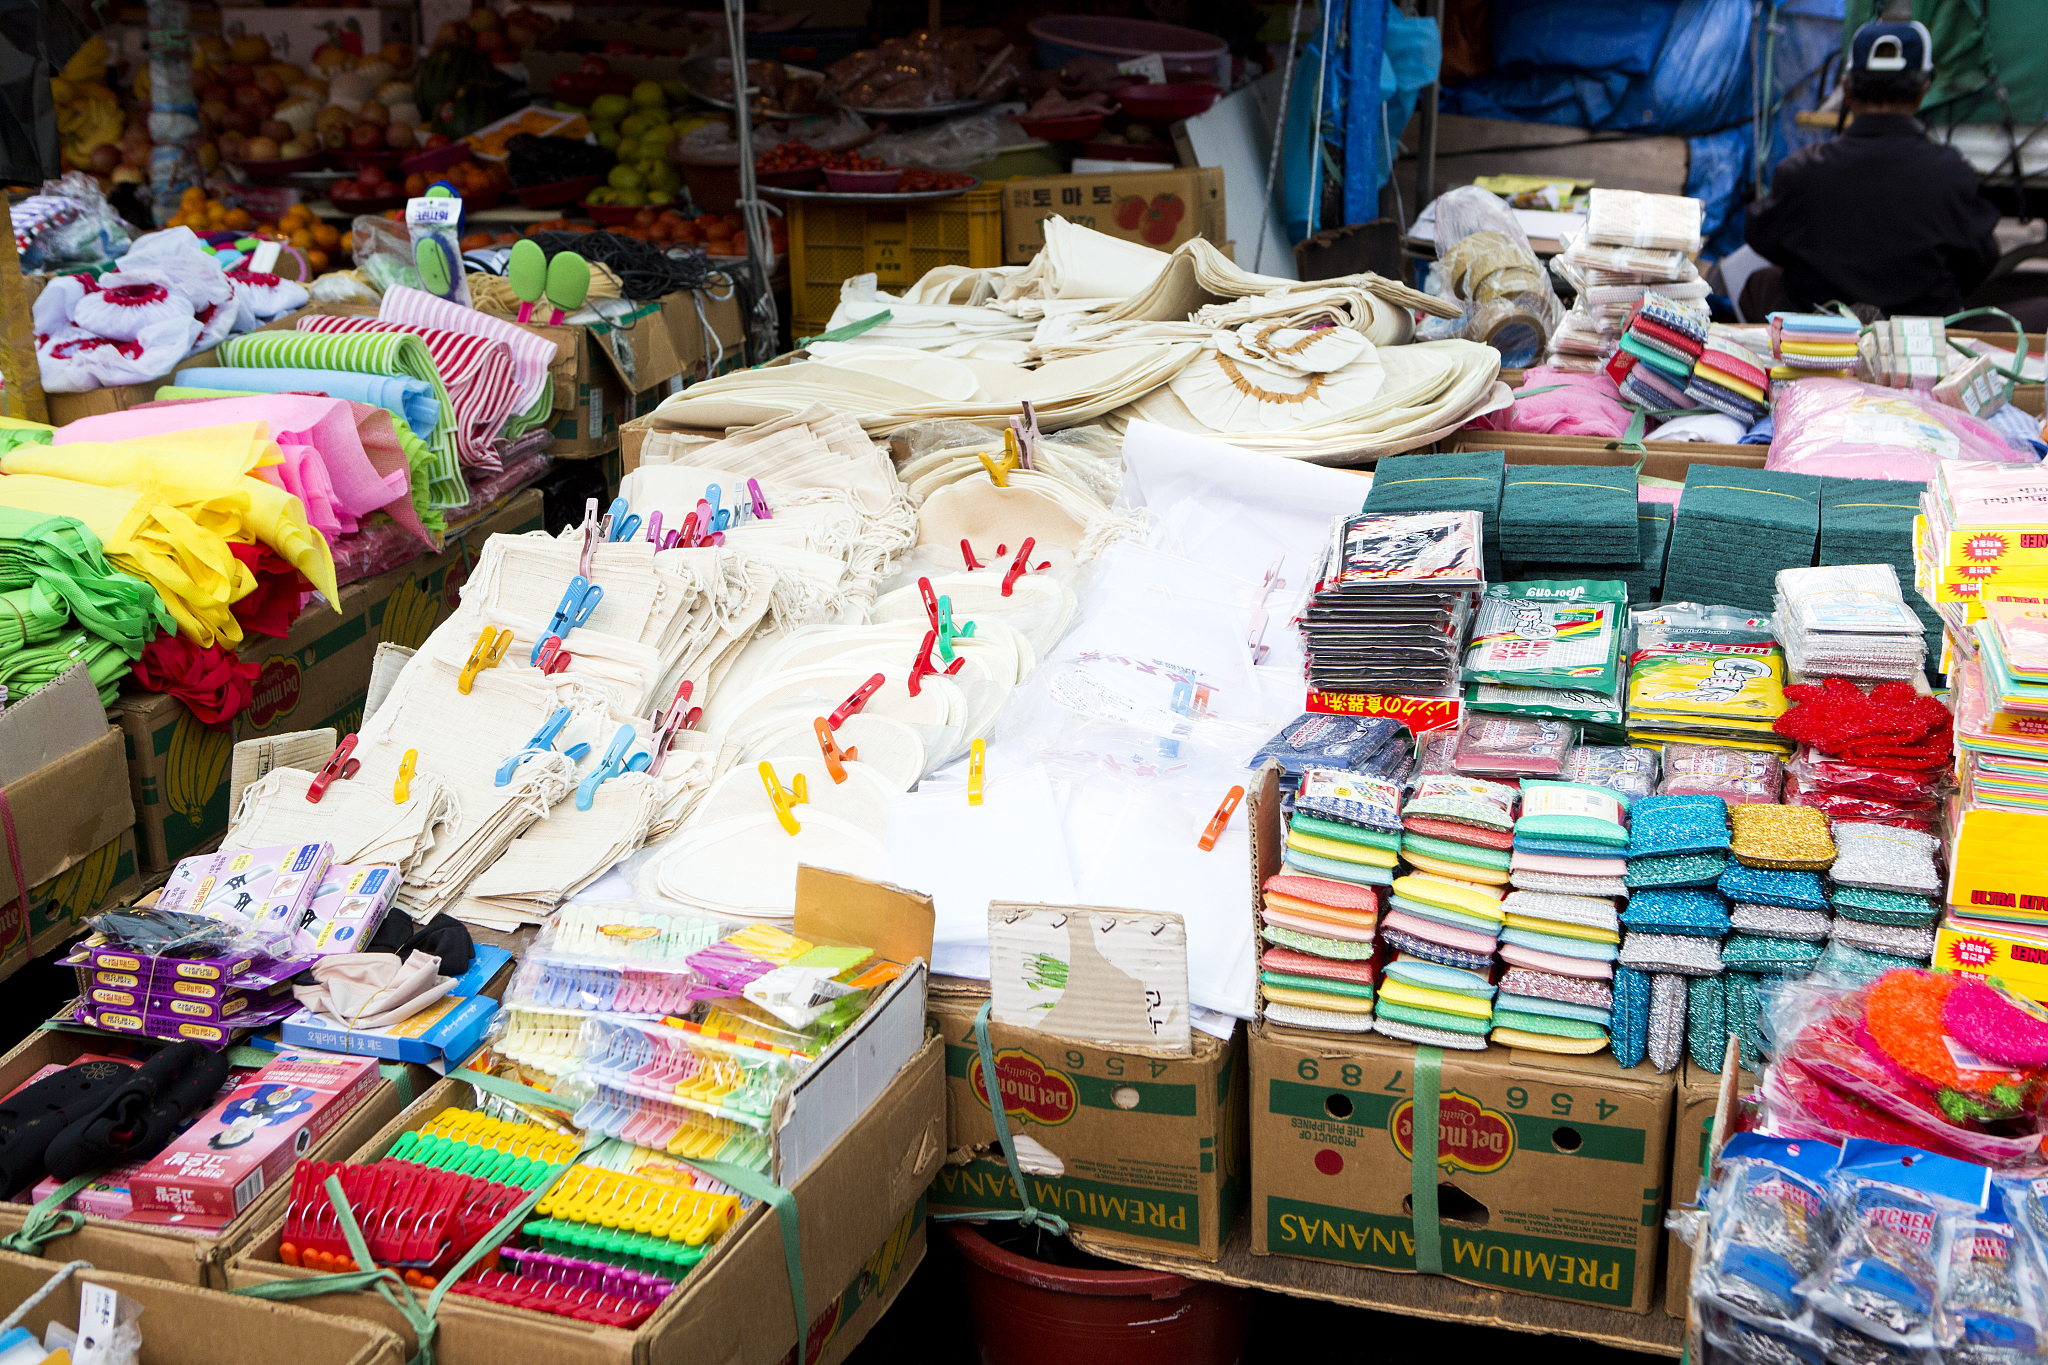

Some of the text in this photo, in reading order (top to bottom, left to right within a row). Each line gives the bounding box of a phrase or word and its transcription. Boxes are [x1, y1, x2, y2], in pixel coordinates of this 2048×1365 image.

[1032, 186, 1112, 207] 토마토
[1035, 214, 1096, 240] TATO
[1983, 496, 2048, 506] autiful
[2020, 534, 2048, 548] NER
[1526, 586, 1585, 600] Sporong
[1971, 890, 2048, 911] ULTRA KITC
[0, 907, 19, 934] nte
[102, 957, 136, 970] 각질패드
[2011, 945, 2048, 965] ANER
[183, 966, 213, 977] 각질양말
[97, 991, 131, 1004] 각질패드
[176, 1002, 207, 1013] 각질양말
[307, 1031, 337, 1046] 오필리아
[367, 1040, 383, 1051] 패드
[1066, 1050, 1085, 1070] 6
[1106, 1057, 1125, 1076] 5
[1147, 1059, 1168, 1079] 4
[978, 1071, 1069, 1110] Del Mone
[1298, 1059, 1619, 1120] 4 5 6 7 8 9
[1438, 1108, 1475, 1125] Qualit
[1291, 1117, 1366, 1138] THE PHILIPPINES
[1401, 1120, 1506, 1154] Del Moe
[1299, 1130, 1358, 1148] PRODUCT OF
[163, 1151, 232, 1169] 고은발
[1098, 1168, 1155, 1181] INTERNATIONAL
[1130, 1178, 1182, 1190] INFORMATION
[1156, 1175, 1183, 1184] MONTE
[155, 1186, 196, 1206] 고은발
[932, 1165, 1187, 1232] PREMIUM BANA
[1529, 1220, 1592, 1233] INTERNATIONAL
[1593, 1227, 1621, 1237] MONTE
[1888, 1223, 1933, 1246] ANER
[1564, 1231, 1620, 1243] INFORMATION
[1279, 1213, 1621, 1291] PREMIUM ANANAS
